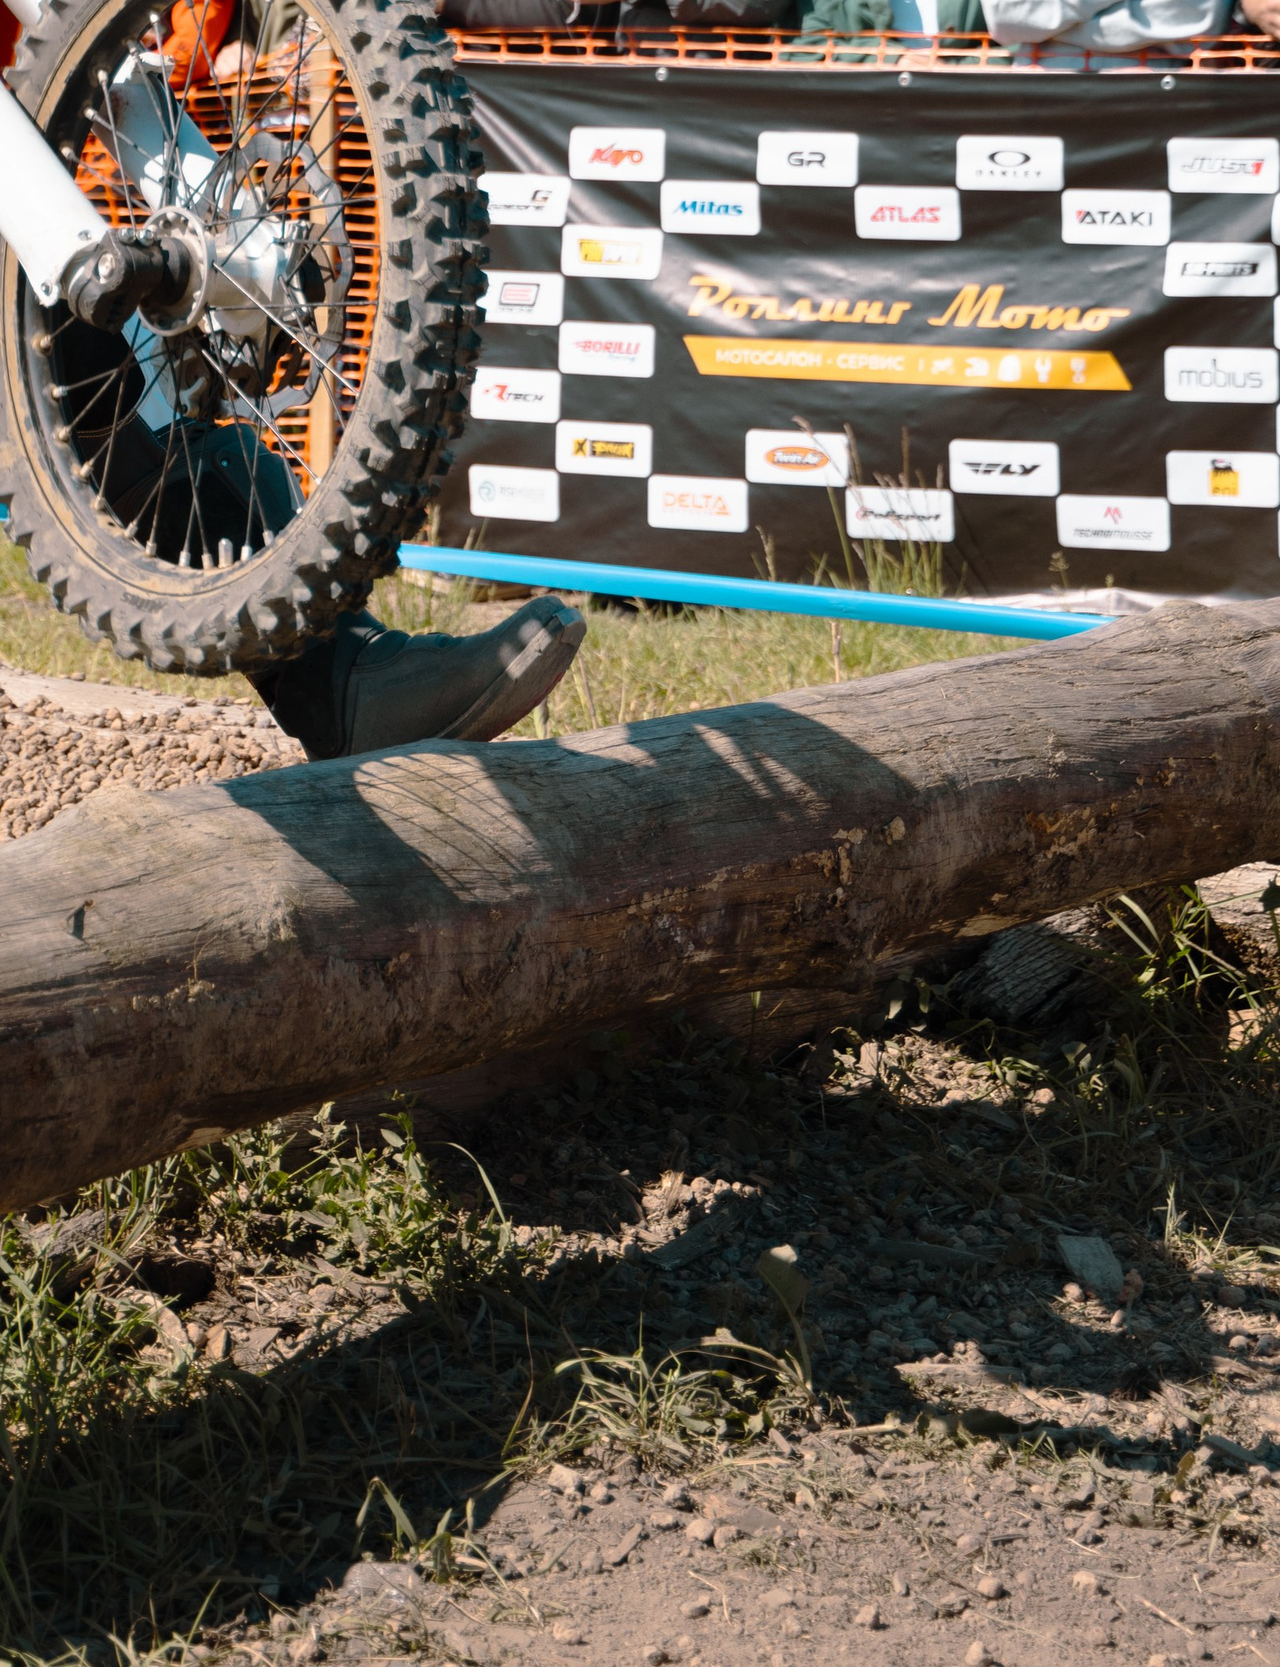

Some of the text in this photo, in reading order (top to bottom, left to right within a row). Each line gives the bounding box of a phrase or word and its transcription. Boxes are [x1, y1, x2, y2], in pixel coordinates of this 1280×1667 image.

[787, 151, 826, 168] GR
[976, 169, 1042, 178] OAKLEY
[673, 200, 743, 215] Mitas
[870, 205, 941, 223] ATLAS
[1077, 210, 1152, 227] ATAKI
[688, 275, 1131, 332] Роллинг Мото
[716, 349, 821, 368] МОТОСАЛОН
[837, 356, 904, 371] СЕРВИС
[1178, 358, 1262, 388] mobius
[663, 492, 729, 515] DELTA
